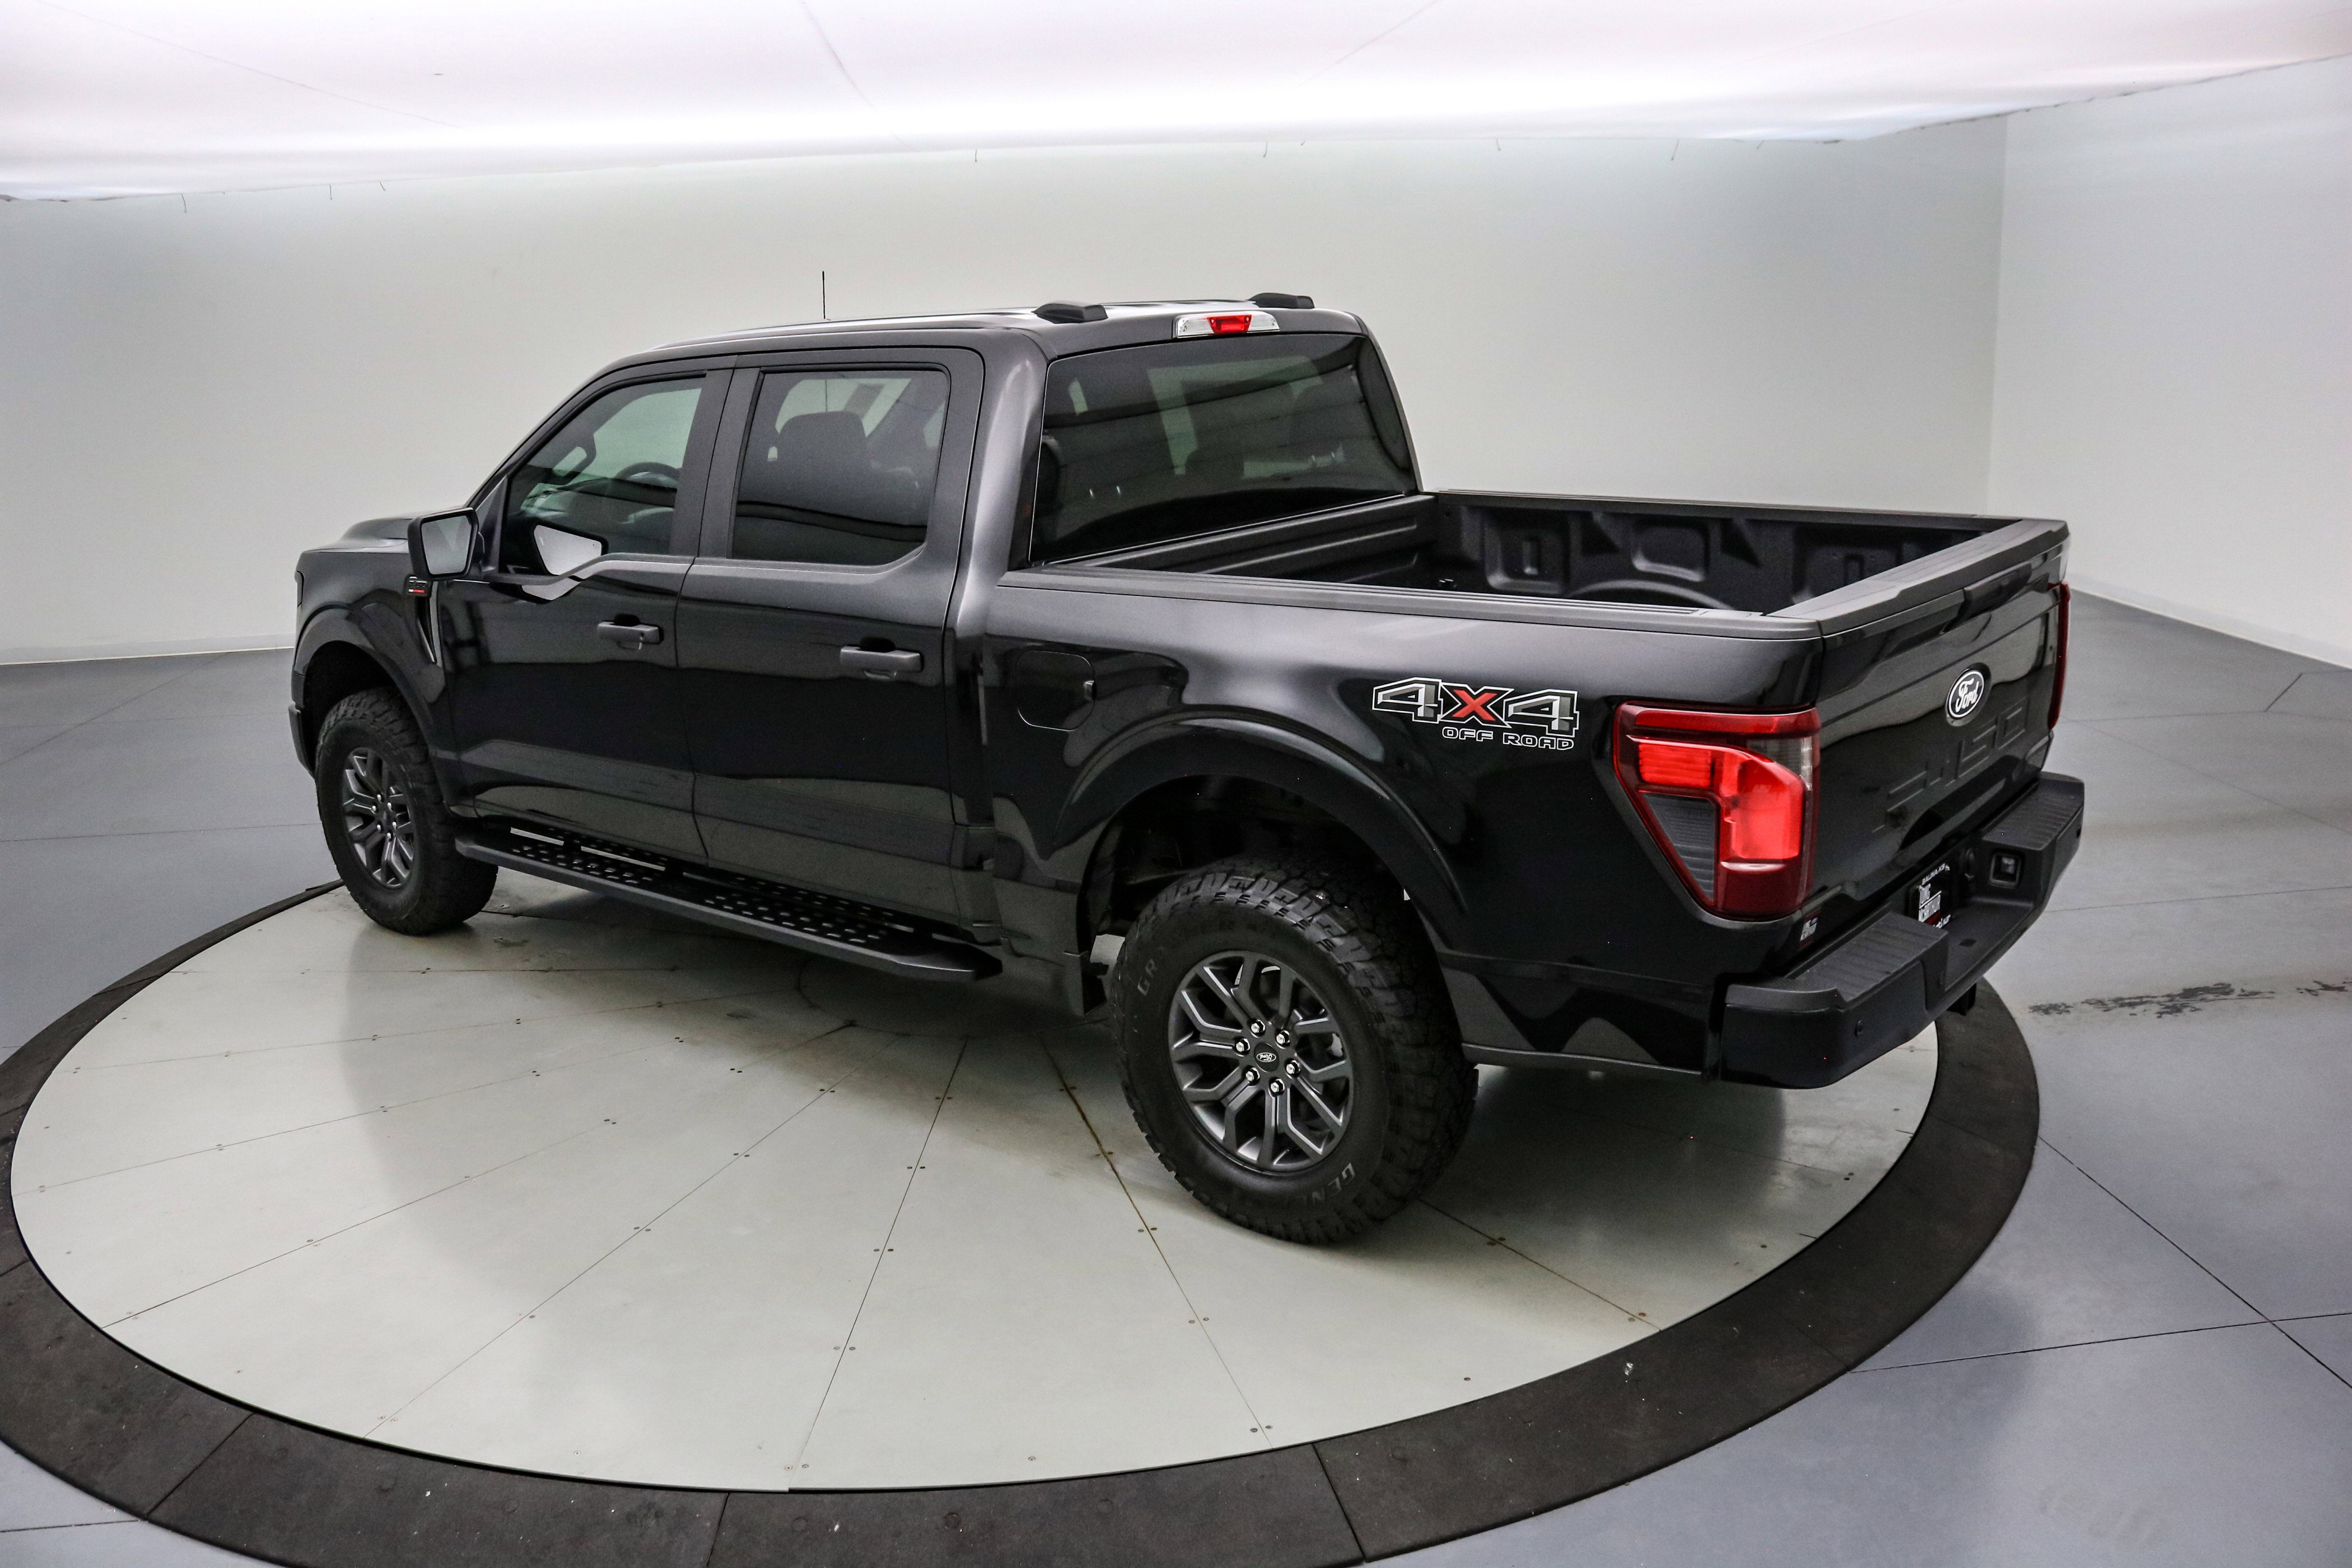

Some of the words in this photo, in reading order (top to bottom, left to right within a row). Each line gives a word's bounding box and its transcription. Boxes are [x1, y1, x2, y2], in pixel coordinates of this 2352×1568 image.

[1955, 677, 1980, 713] Ford
[1442, 726, 1494, 742] OFF
[1503, 732, 1574, 751] ROAD
